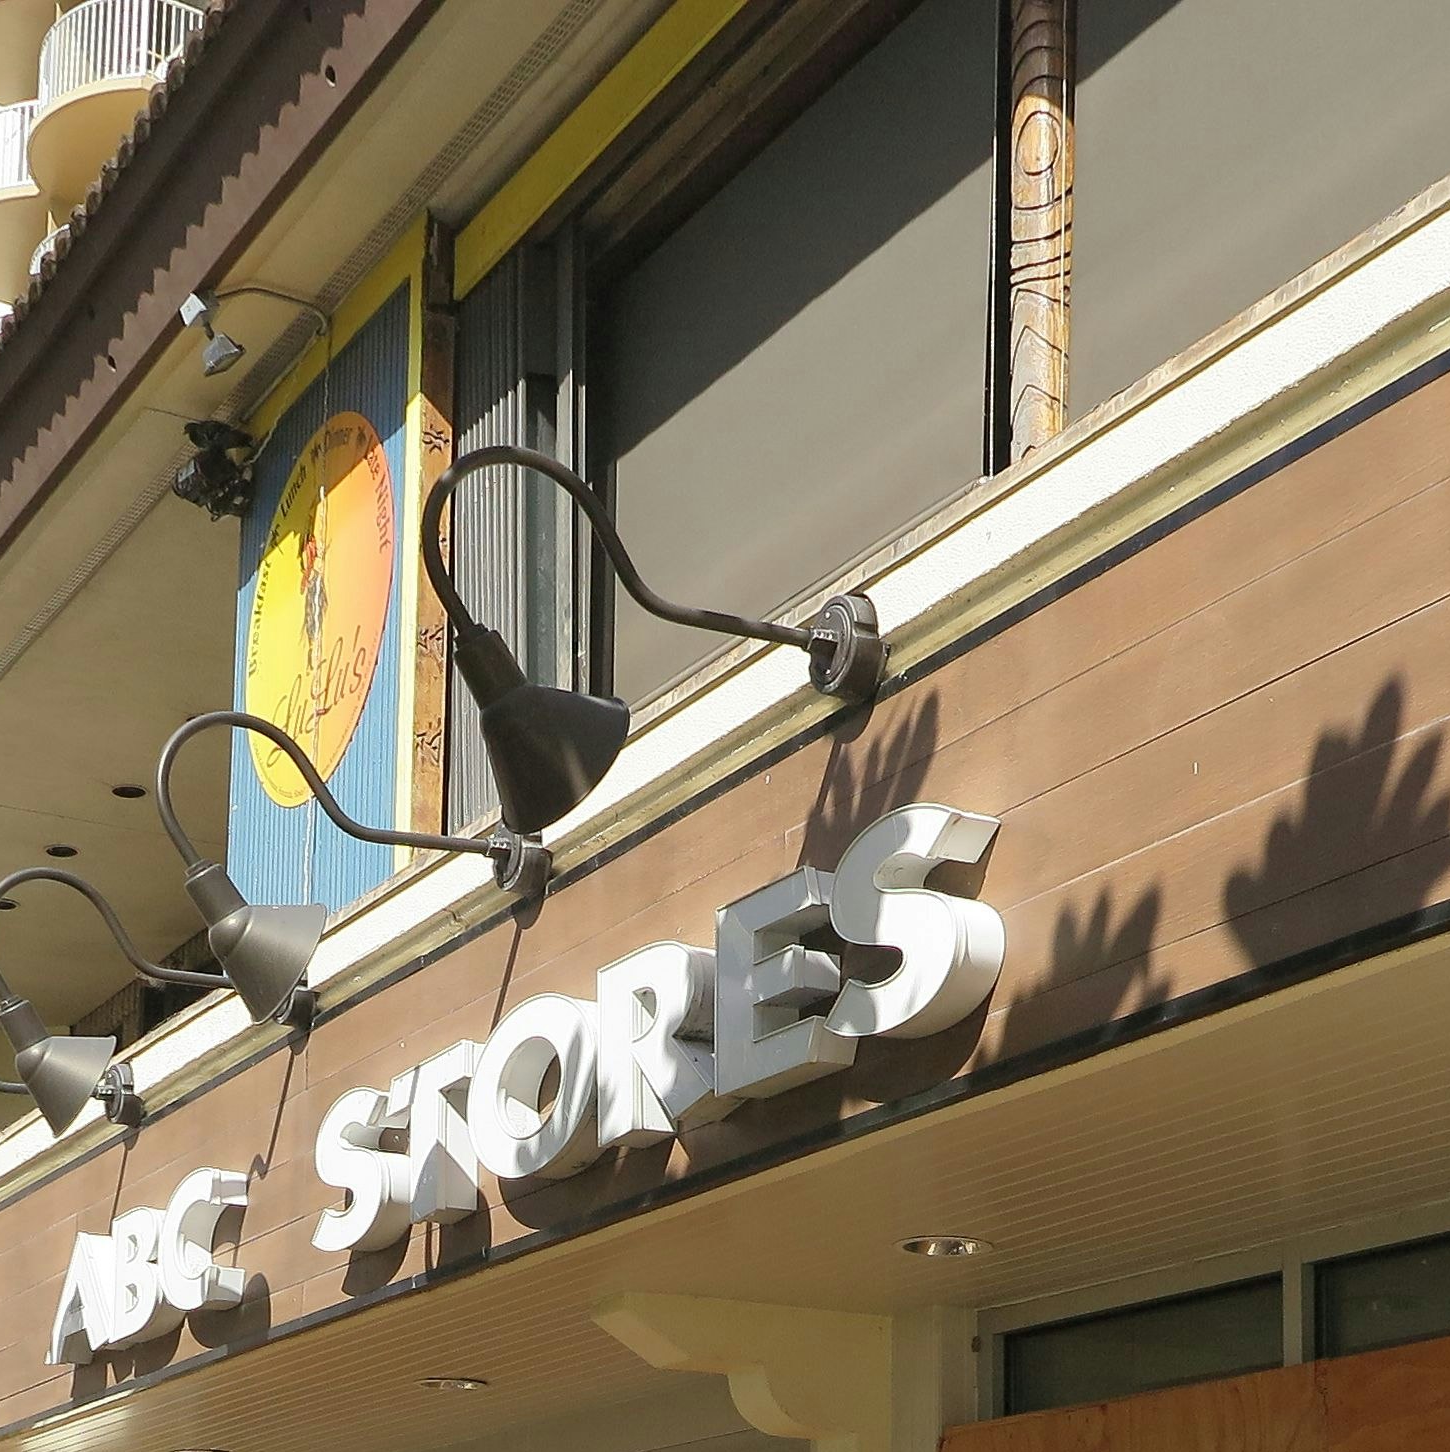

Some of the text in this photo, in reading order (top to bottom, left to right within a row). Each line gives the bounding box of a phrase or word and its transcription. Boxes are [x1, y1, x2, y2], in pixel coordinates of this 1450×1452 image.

[280, 465, 307, 518] Lunch
[375, 472, 392, 555] Night
[45, 802, 1006, 1366] ABC STORES
